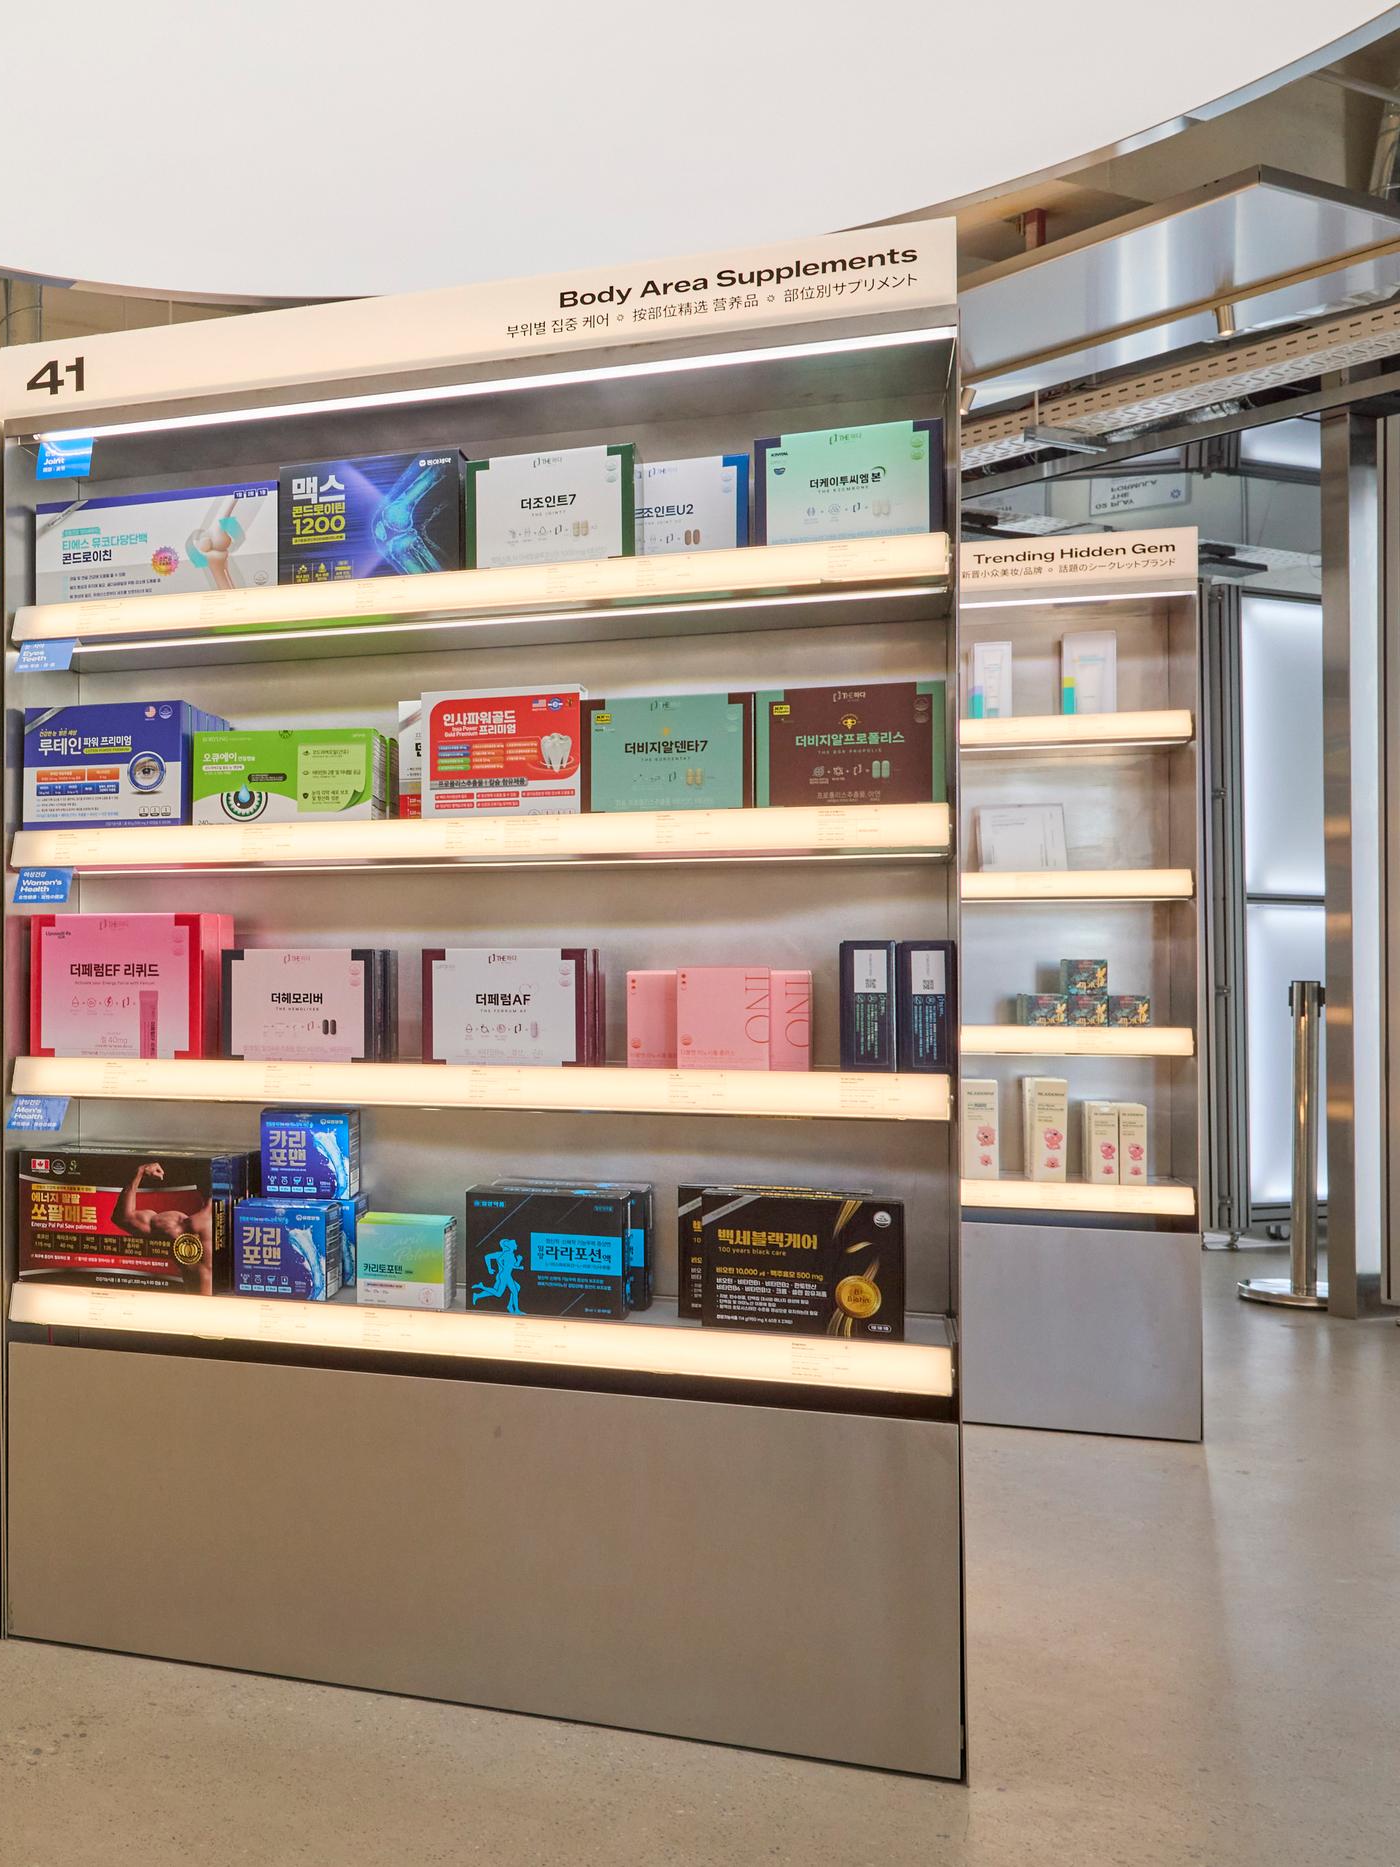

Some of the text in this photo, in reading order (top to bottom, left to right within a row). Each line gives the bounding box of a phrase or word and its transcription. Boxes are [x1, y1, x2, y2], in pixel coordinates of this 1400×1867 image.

[559, 248, 918, 308] Body Area Supplements
[783, 272, 918, 303] 部位別サプリメント
[632, 293, 759, 323] 按部位精选 营养品
[506, 312, 610, 338] 부위별 집중 케어
[26, 356, 85, 395] 41
[44, 457, 66, 466] Joint
[292, 474, 345, 504] 맥스
[810, 472, 881, 489] 더케이투씨엠 본
[292, 502, 346, 518] 콘드로이틴
[520, 493, 577, 511] 더조인트7
[292, 515, 346, 535] 1200
[62, 533, 148, 550] 티에스 뮤코다당단백
[62, 549, 112, 565] 콘드로이친
[973, 543, 1176, 565] Trending Hidden Gem
[1058, 558, 1176, 574] 話題のシークレットブランド
[443, 710, 516, 727] 인사파워골드
[479, 724, 516, 735] 프리미엄
[38, 736, 132, 756] 루테인 파워 프리미엄
[624, 740, 708, 755] 더비지알덴타7
[795, 731, 905, 747] 더비지알프로폴리스
[202, 752, 237, 762] 오큐에이
[22, 879, 63, 887] Women's
[70, 963, 160, 978] 더페럼EF 리퀴드
[271, 992, 323, 1004] 더헤모리버
[475, 993, 531, 1006] 더페럼AF
[269, 1130, 306, 1148] 카리
[269, 1148, 306, 1167] 포맨
[31, 1192, 59, 1203] 에너지
[31, 1203, 98, 1224] 쏘팔메토
[242, 1227, 281, 1245] 카리
[717, 1229, 818, 1250] 백세블랙케어
[242, 1246, 281, 1265] 포맨
[545, 1246, 611, 1263] 라라포션 액
[752, 1247, 770, 1255] black
[363, 1263, 403, 1274] 카리토포텐
[735, 1267, 758, 1276] 10,000
[770, 1270, 796, 1278] 맥주효모
